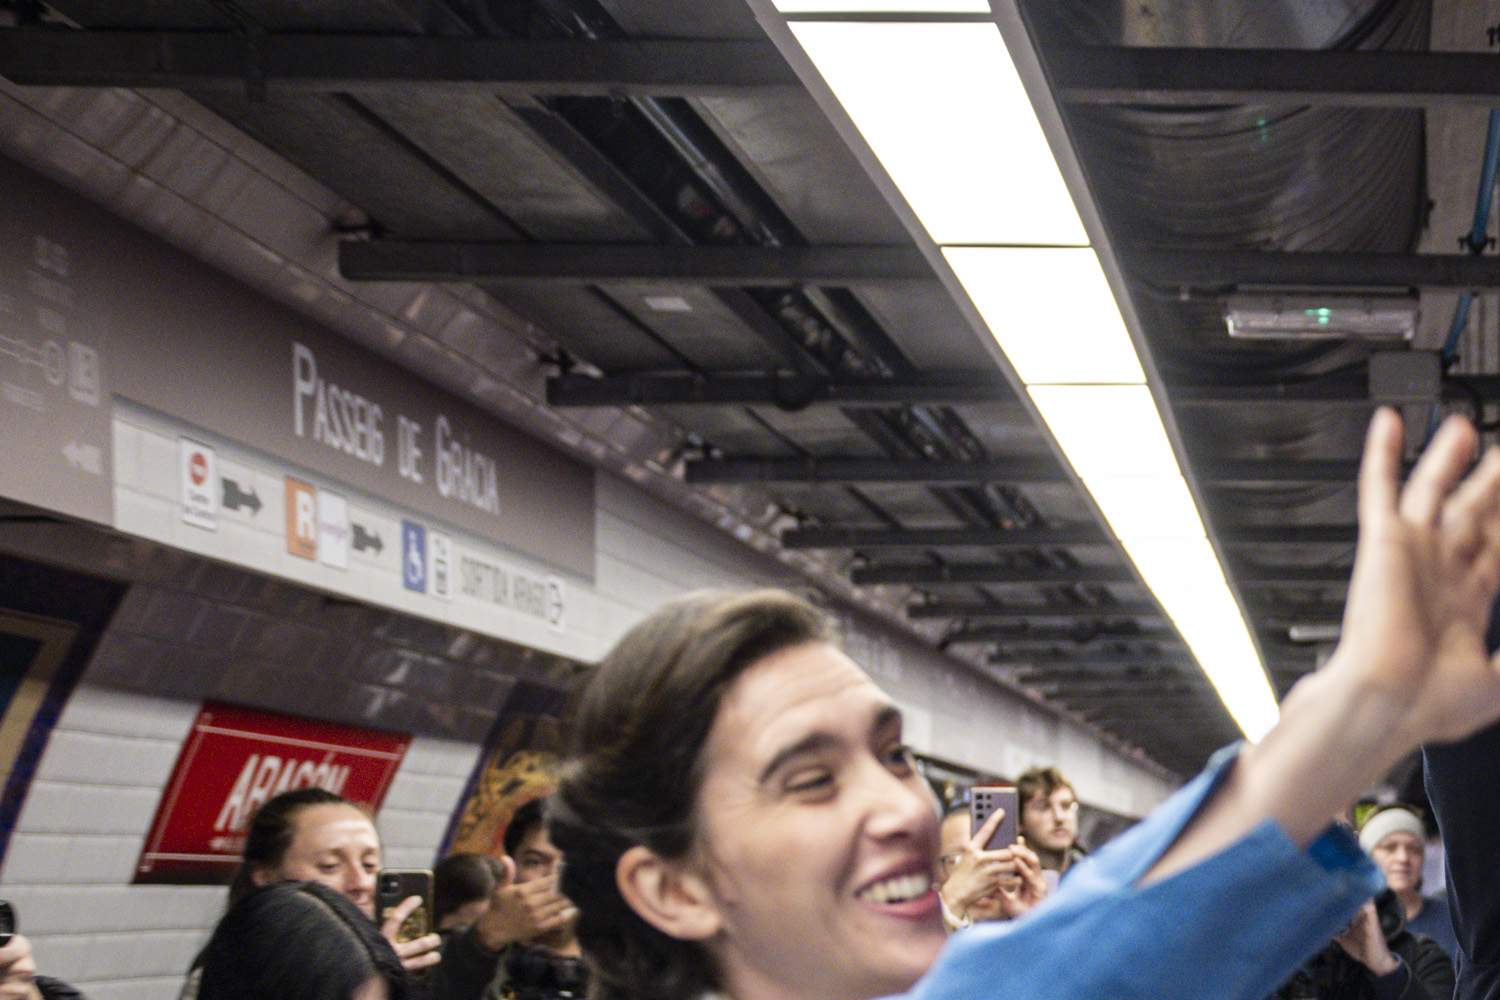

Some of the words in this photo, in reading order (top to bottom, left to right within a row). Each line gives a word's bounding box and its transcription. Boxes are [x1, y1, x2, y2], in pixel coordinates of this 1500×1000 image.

[293, 340, 384, 467] PASSEIG
[398, 413, 423, 484] DE
[295, 489, 317, 543] R
